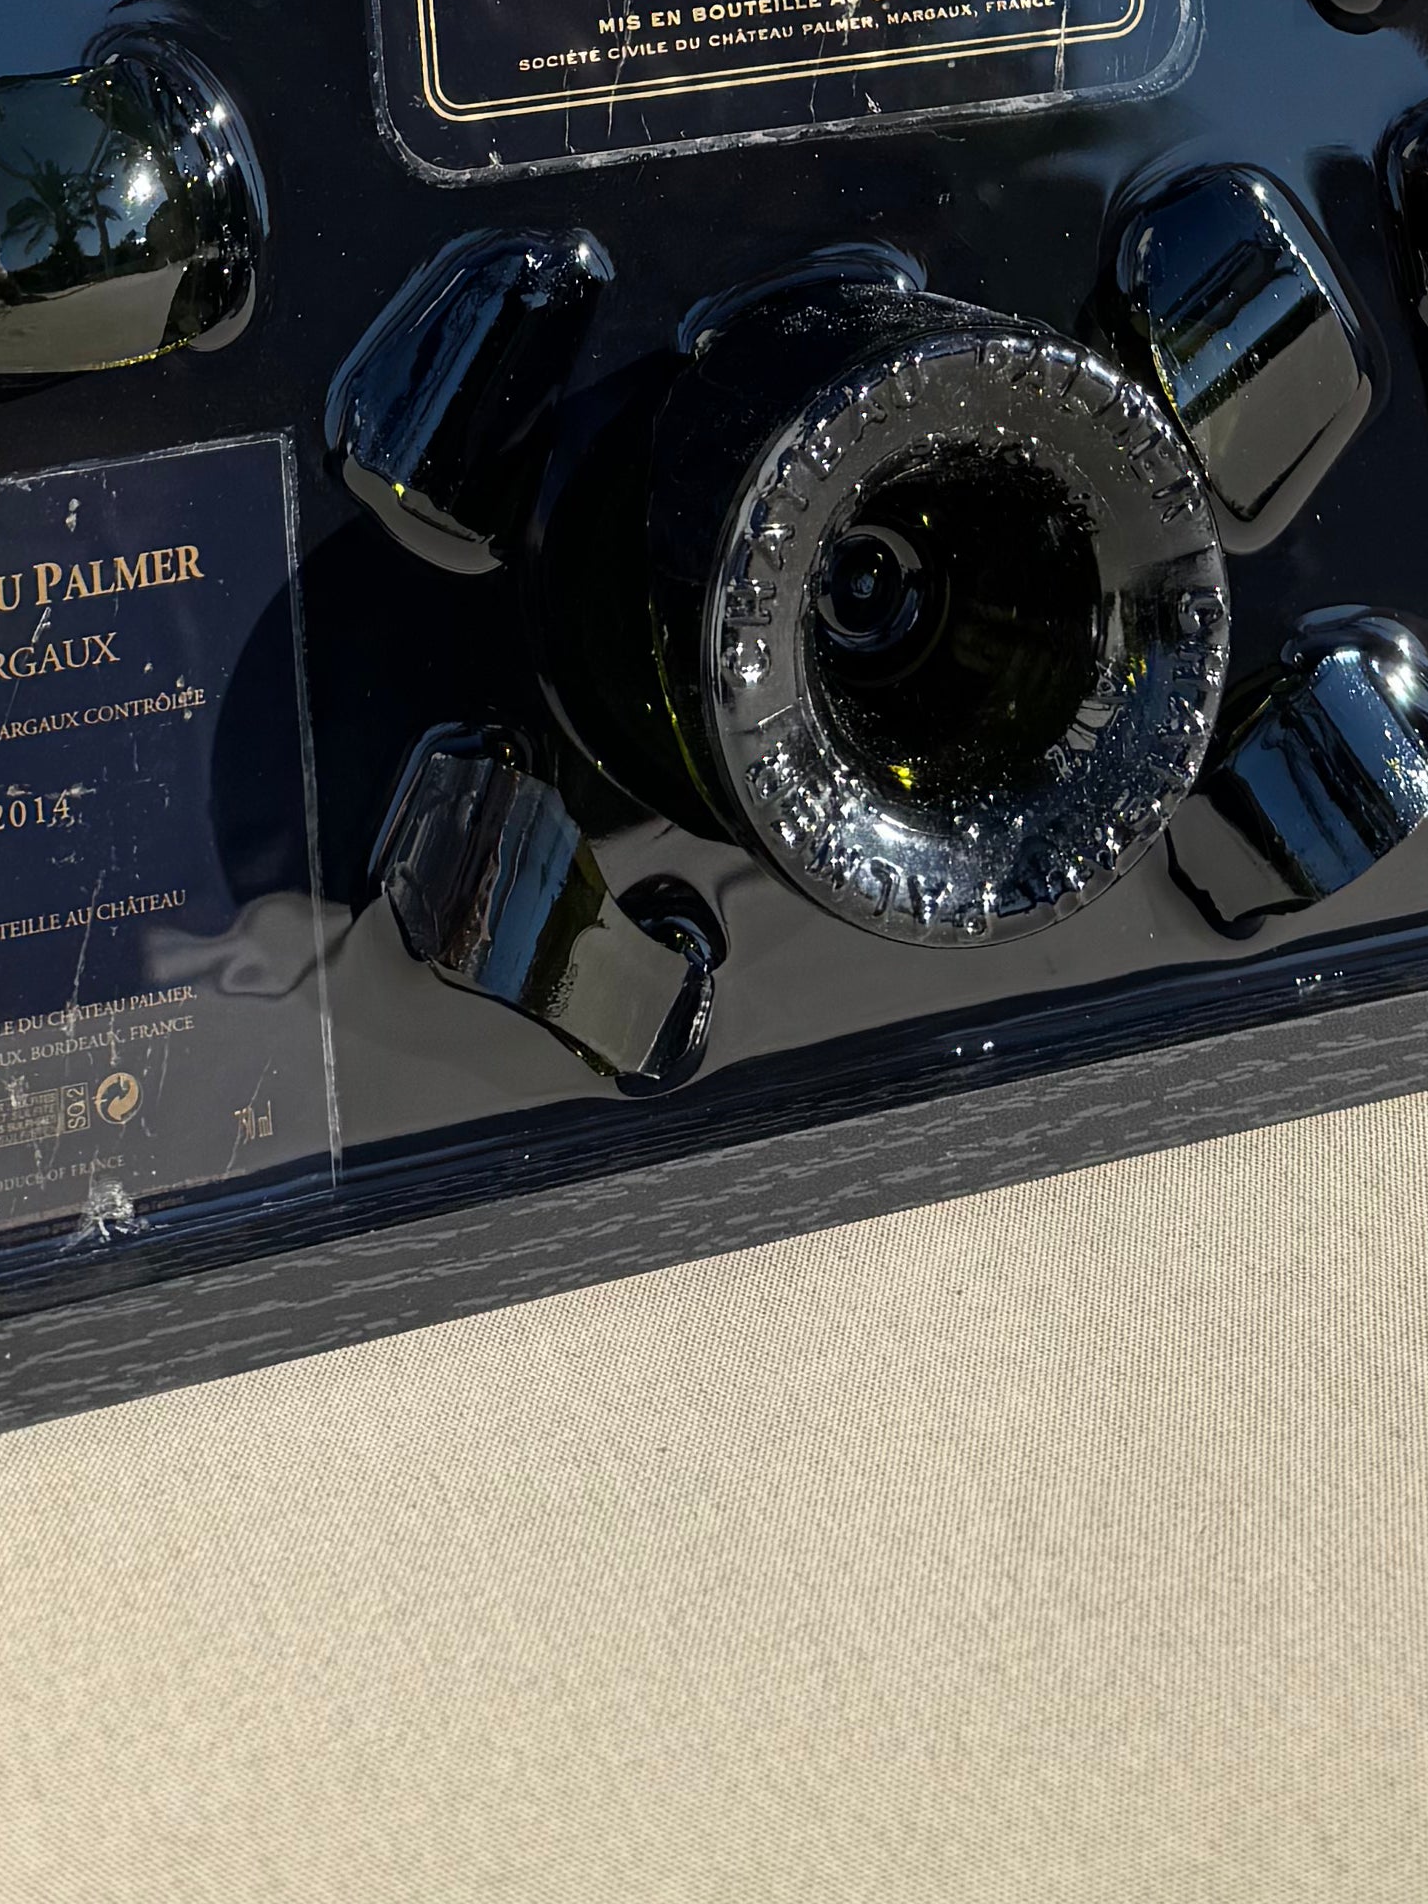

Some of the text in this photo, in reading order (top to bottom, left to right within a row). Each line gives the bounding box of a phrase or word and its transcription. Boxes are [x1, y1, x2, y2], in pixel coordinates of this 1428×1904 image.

[518, 45, 602, 71] SOCIÉTÉ
[607, 41, 668, 60] CIVILE
[675, 36, 700, 51] DU
[708, 25, 793, 48] CHÂTEAU
[802, 14, 880, 37] PALMER,
[887, 3, 978, 25] MARGAUX,
[599, 14, 641, 35] MIS
[651, 9, 682, 28] EN
[33, 544, 205, 606] PALMER
[66, 907, 92, 928] AU
[95, 889, 187, 922] CHÂTEAU
[18, 1014, 44, 1035] DU
[129, 985, 198, 1011] PALMER,
[129, 1015, 195, 1041] FRANCE
[46, 1166, 66, 1182] OF
[70, 1155, 126, 1177] FRANCE
